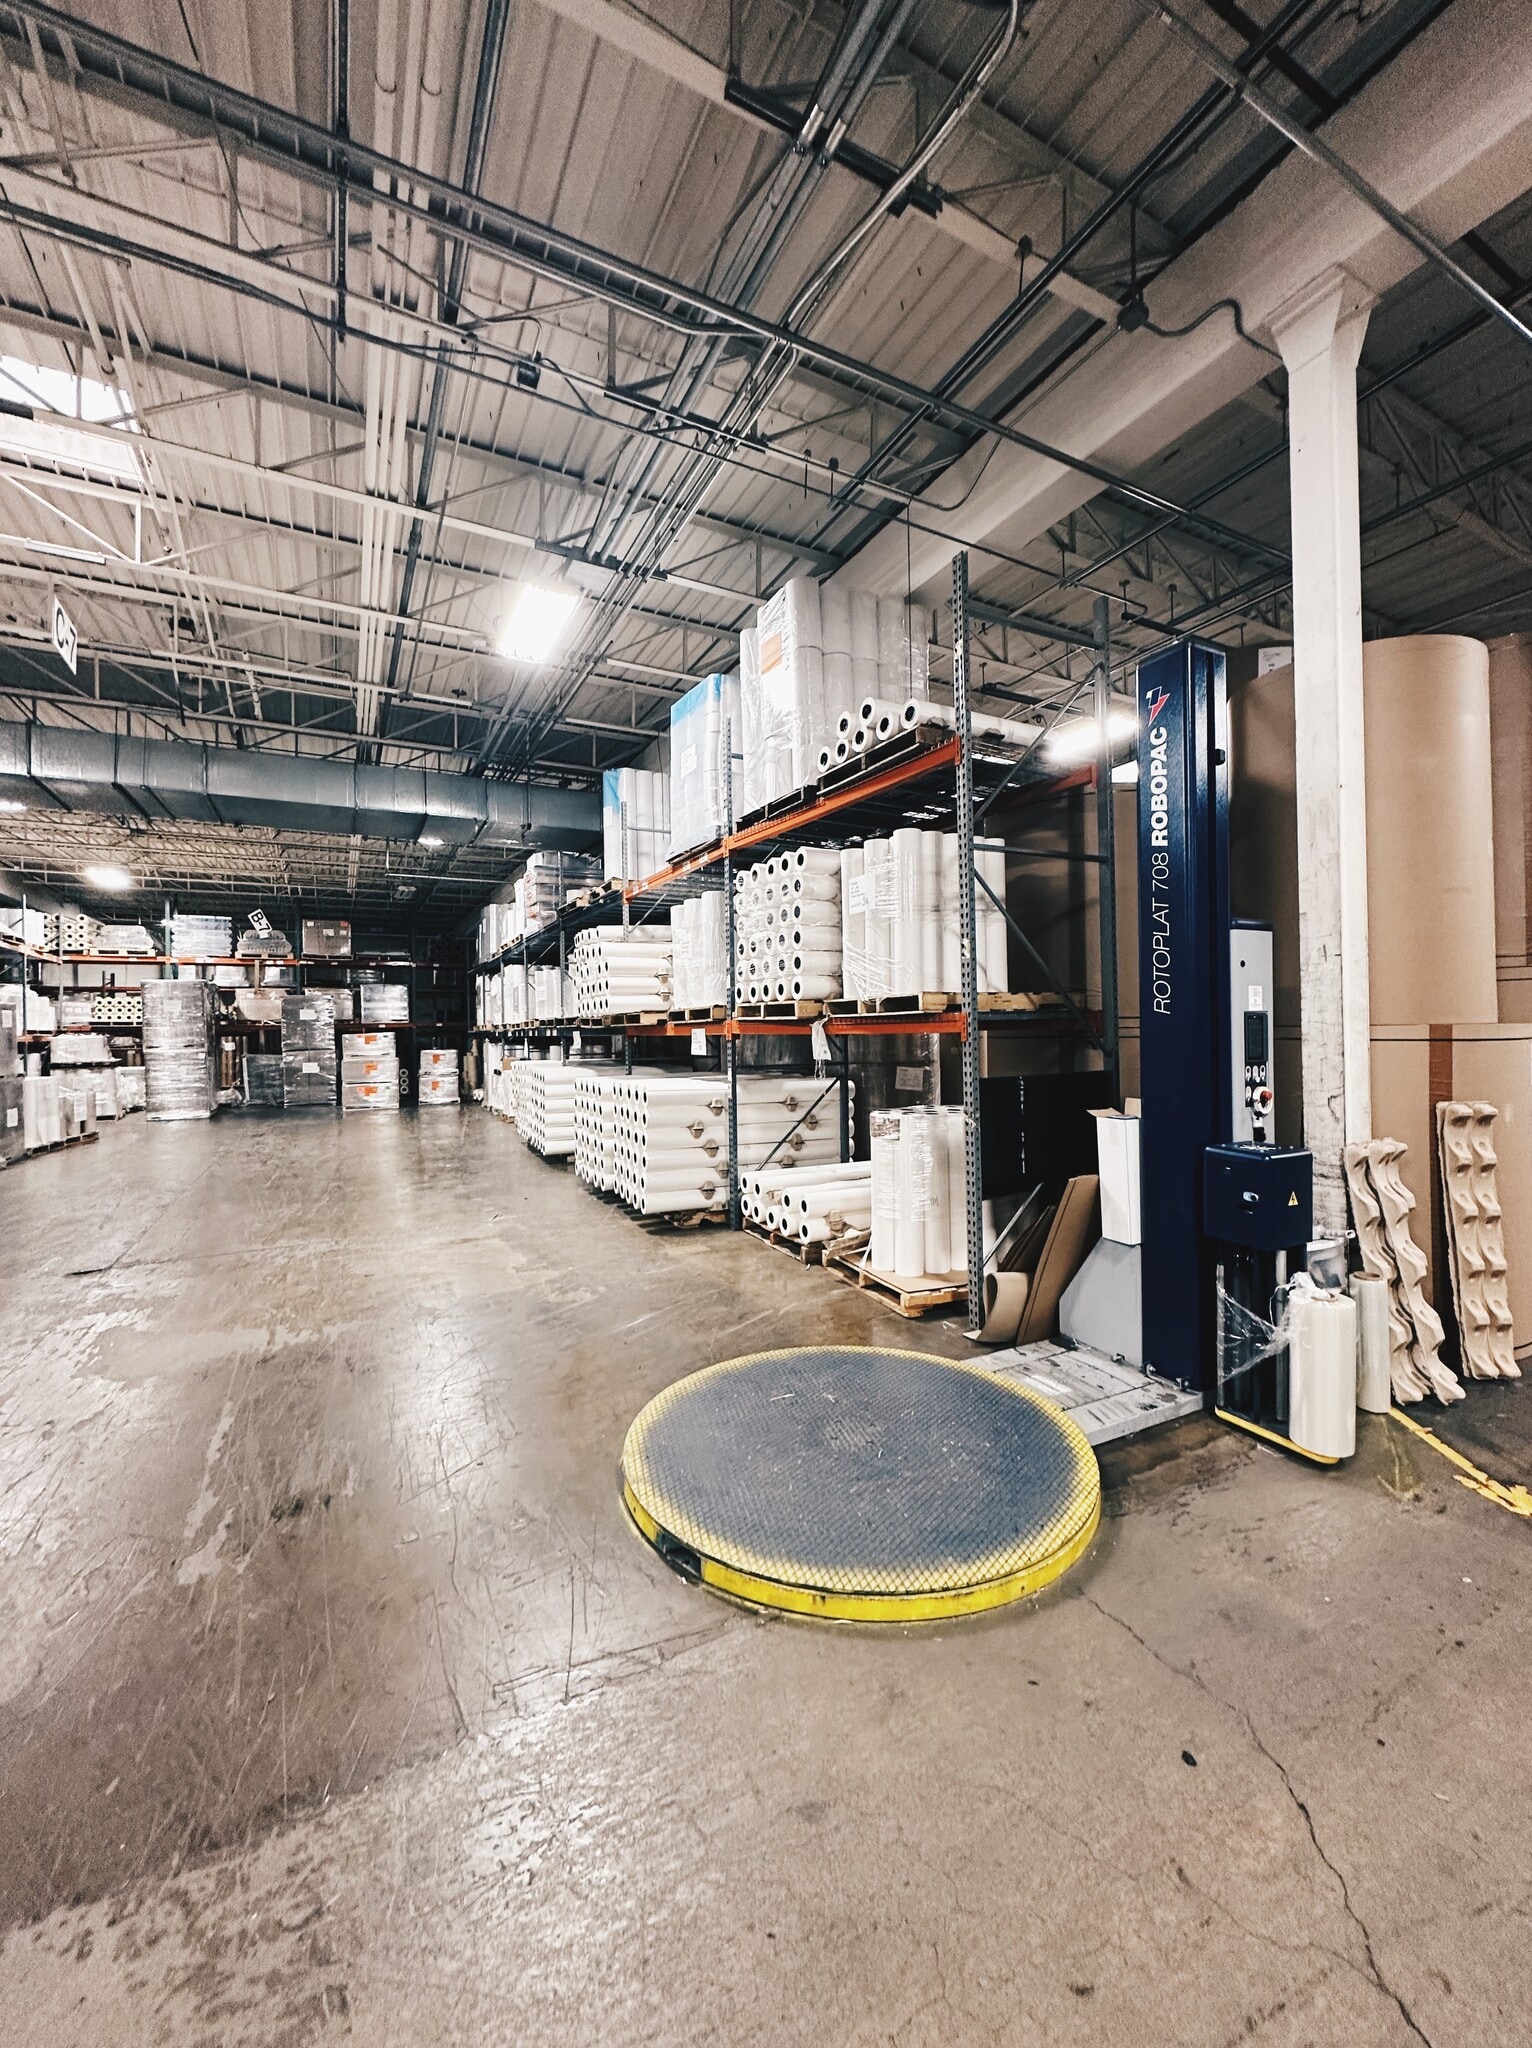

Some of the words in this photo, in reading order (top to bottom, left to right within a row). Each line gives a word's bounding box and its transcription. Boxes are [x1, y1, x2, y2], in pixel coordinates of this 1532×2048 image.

[56, 607, 76, 663] C-7
[1150, 726, 1169, 847] ROBOPAC
[1151, 852, 1170, 892] 708
[251, 912, 271, 932] B-7
[1152, 897, 1171, 1015] ROTOPLAT
